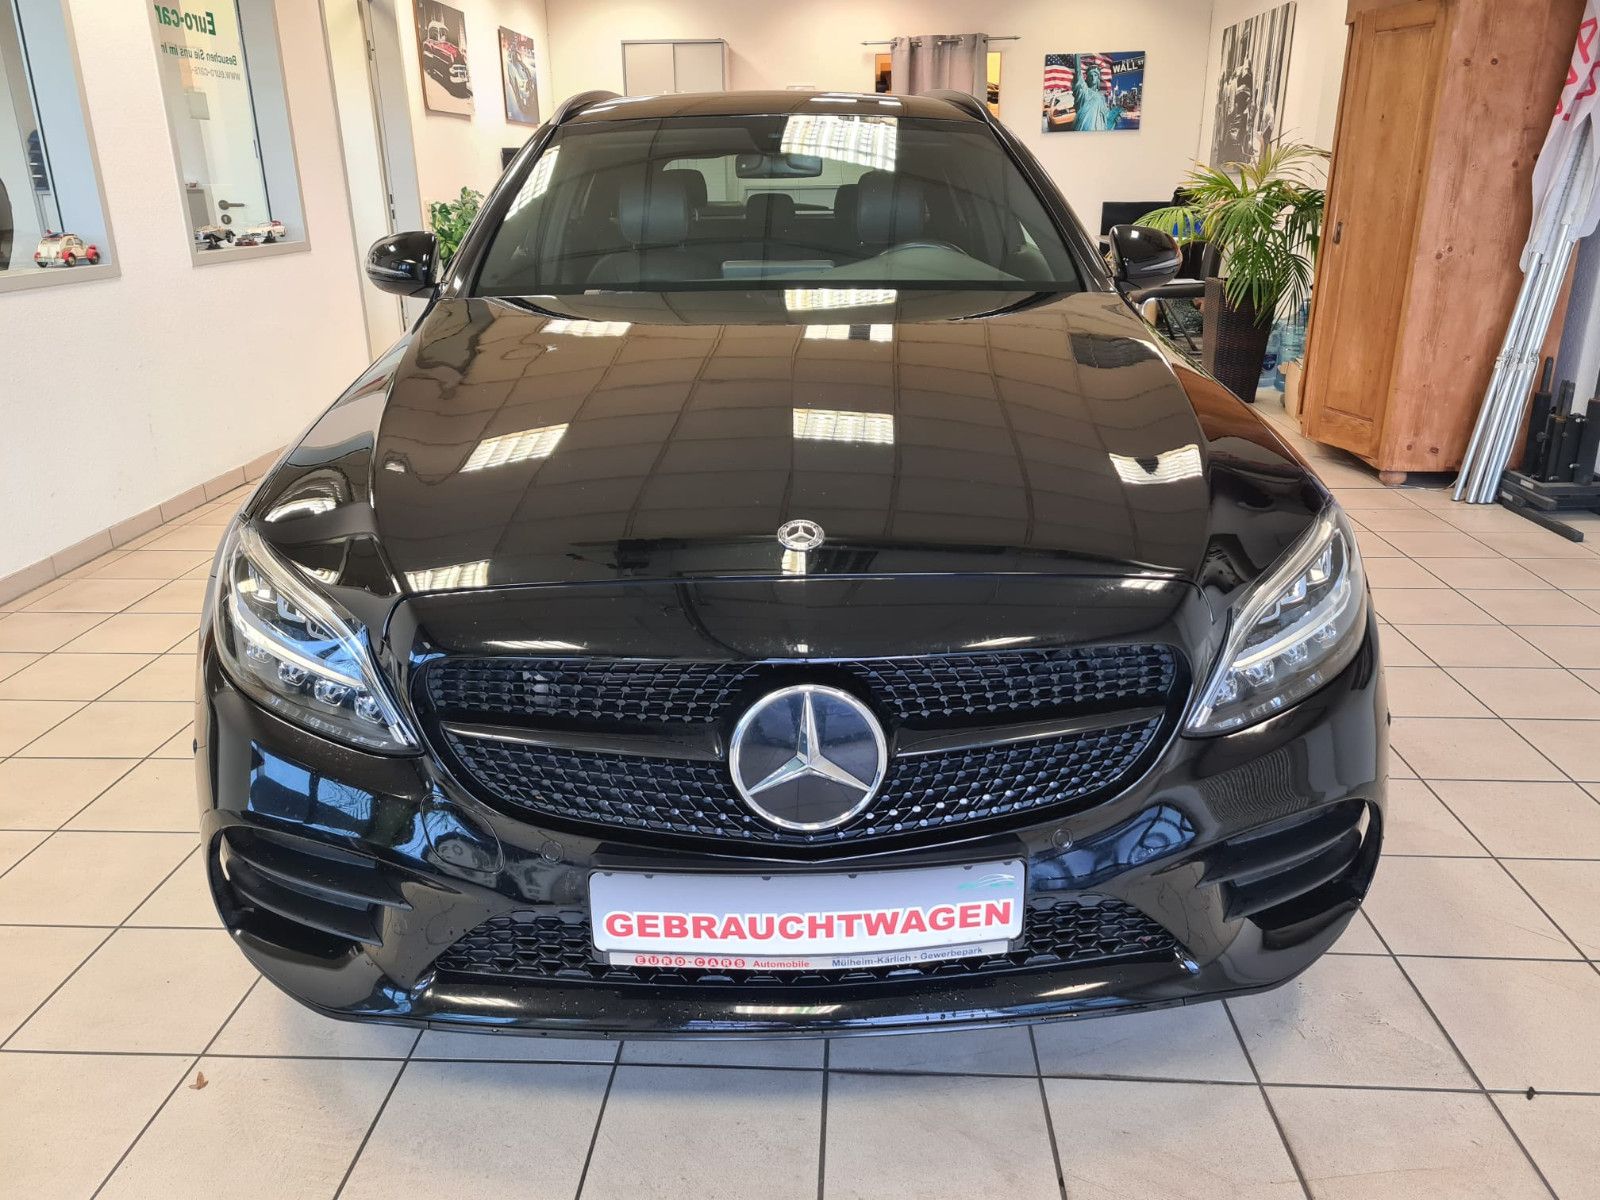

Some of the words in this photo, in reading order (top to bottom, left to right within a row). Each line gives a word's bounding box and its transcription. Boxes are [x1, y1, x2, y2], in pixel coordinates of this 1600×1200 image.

[1112, 61, 1138, 74] WALL
[605, 901, 1011, 940] GEBRAUCHTWAGEN
[635, 954, 746, 968] EURO-CARS
[753, 958, 810, 968] Automobile
[832, 953, 911, 967] Mülheim-Kärlich
[920, 946, 983, 960] Gewerbepark
